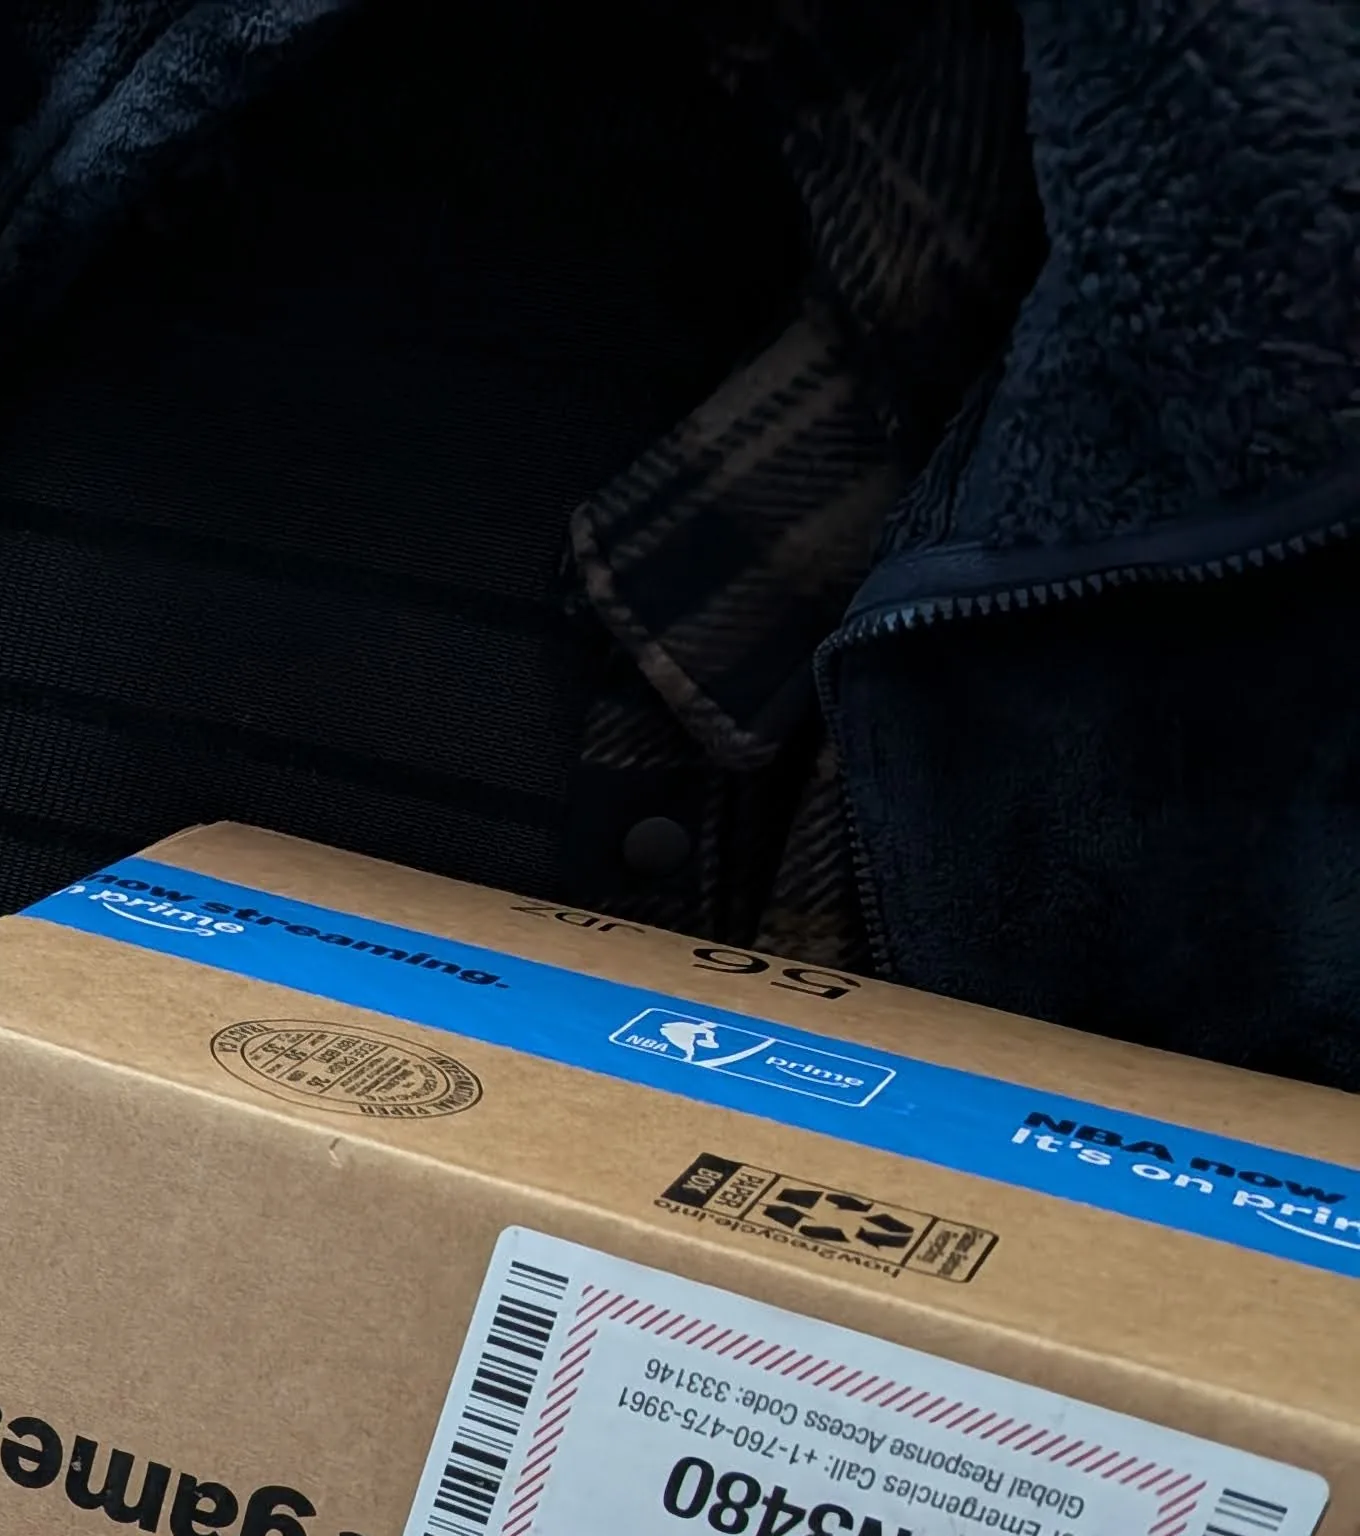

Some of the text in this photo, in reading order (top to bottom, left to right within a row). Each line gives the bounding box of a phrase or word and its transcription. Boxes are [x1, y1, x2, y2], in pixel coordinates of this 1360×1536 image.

[87, 888, 245, 934] prime
[198, 898, 510, 990] streaming.
[691, 946, 863, 1001] 56
[624, 1032, 671, 1054] NBA
[765, 1054, 866, 1088] prime
[681, 1166, 725, 1196] BOX
[1010, 1126, 1360, 1234] It's on pri
[1023, 1110, 1349, 1205] NBA now
[716, 1172, 766, 1210] PAPER
[653, 1198, 902, 1279] how2recycle.info
[617, 1385, 819, 1466] +1-760-475-3961
[643, 1357, 1086, 1521] Global Response Access Code: 333146
[823, 1453, 877, 1491] Call:
